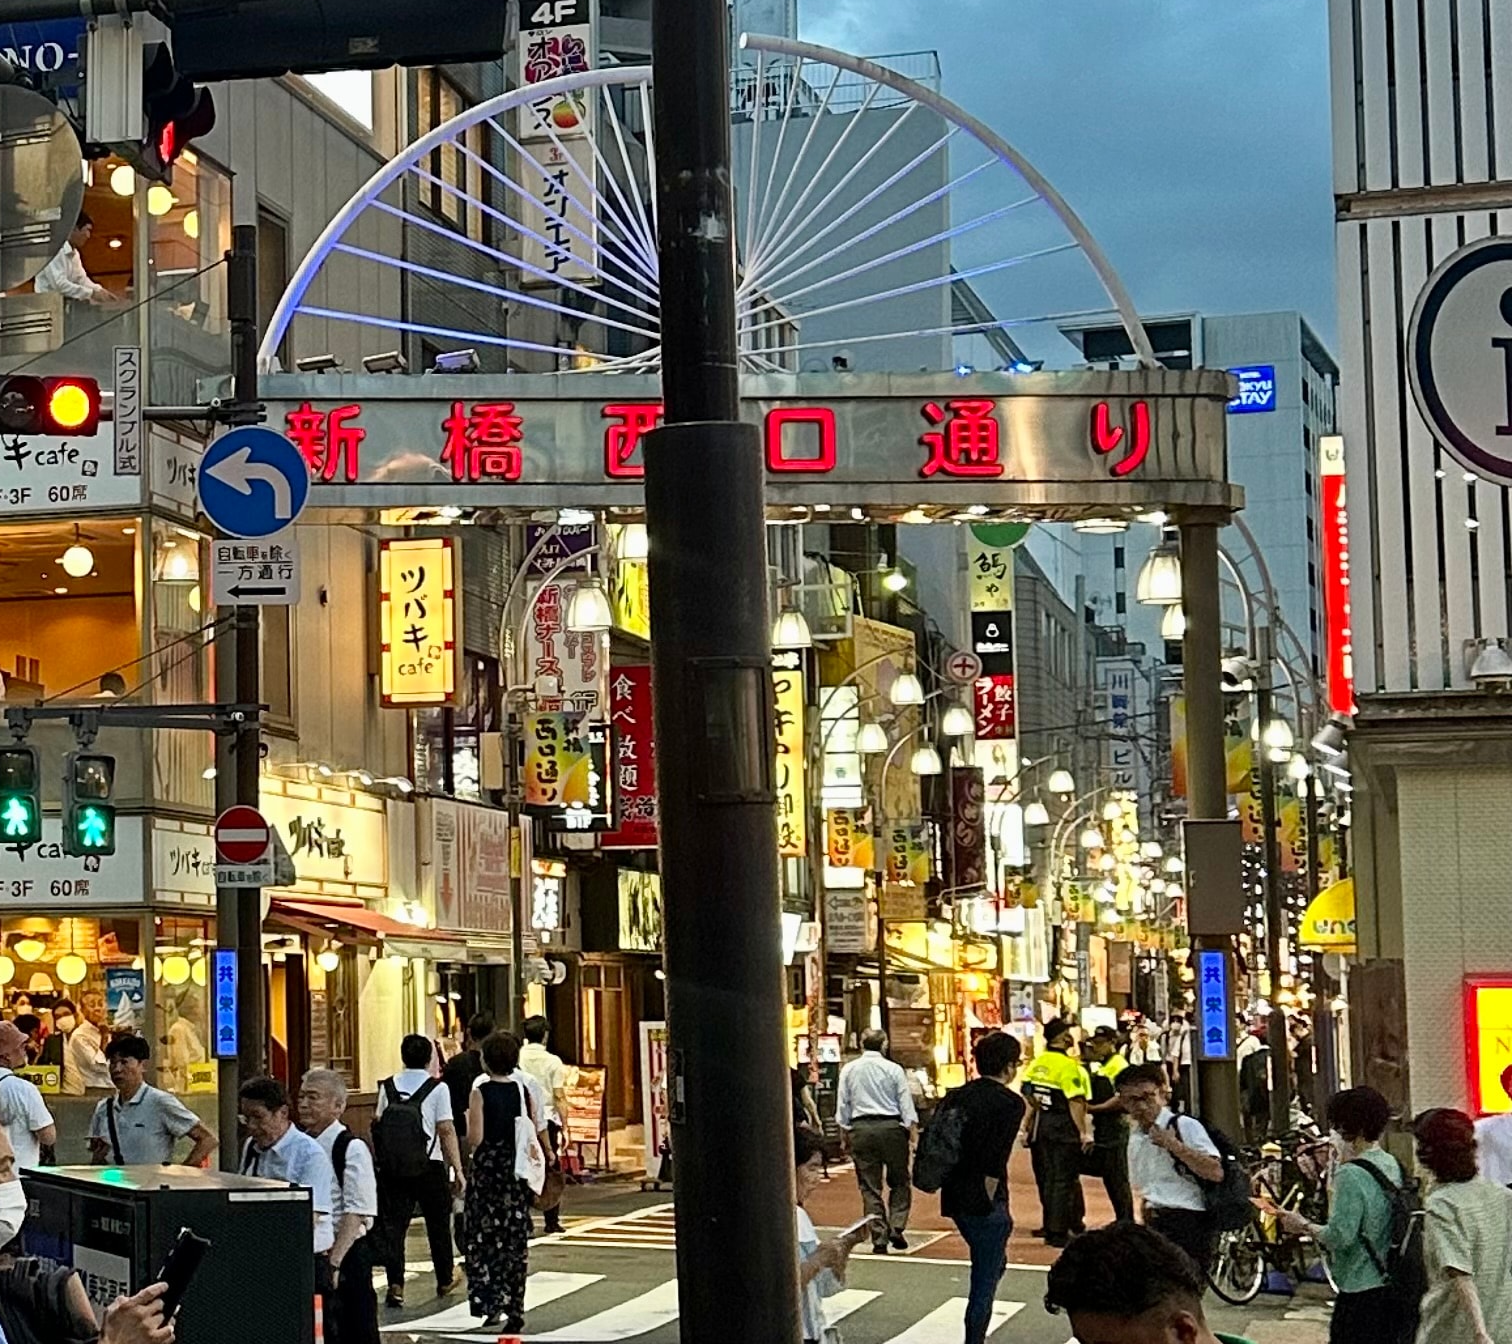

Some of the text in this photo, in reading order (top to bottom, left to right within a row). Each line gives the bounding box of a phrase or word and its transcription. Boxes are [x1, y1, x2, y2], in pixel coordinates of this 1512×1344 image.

[118, 351, 138, 471] スクランブル式
[285, 396, 1151, 483] 新橋西口通り
[35, 441, 80, 468] cafe
[217, 544, 293, 562] 自転車を除く
[217, 564, 294, 581] 一方通行
[400, 564, 430, 653] ツバキ
[397, 656, 434, 677] cafe
[975, 676, 995, 738] ラーメン
[535, 718, 559, 803] 西口通り
